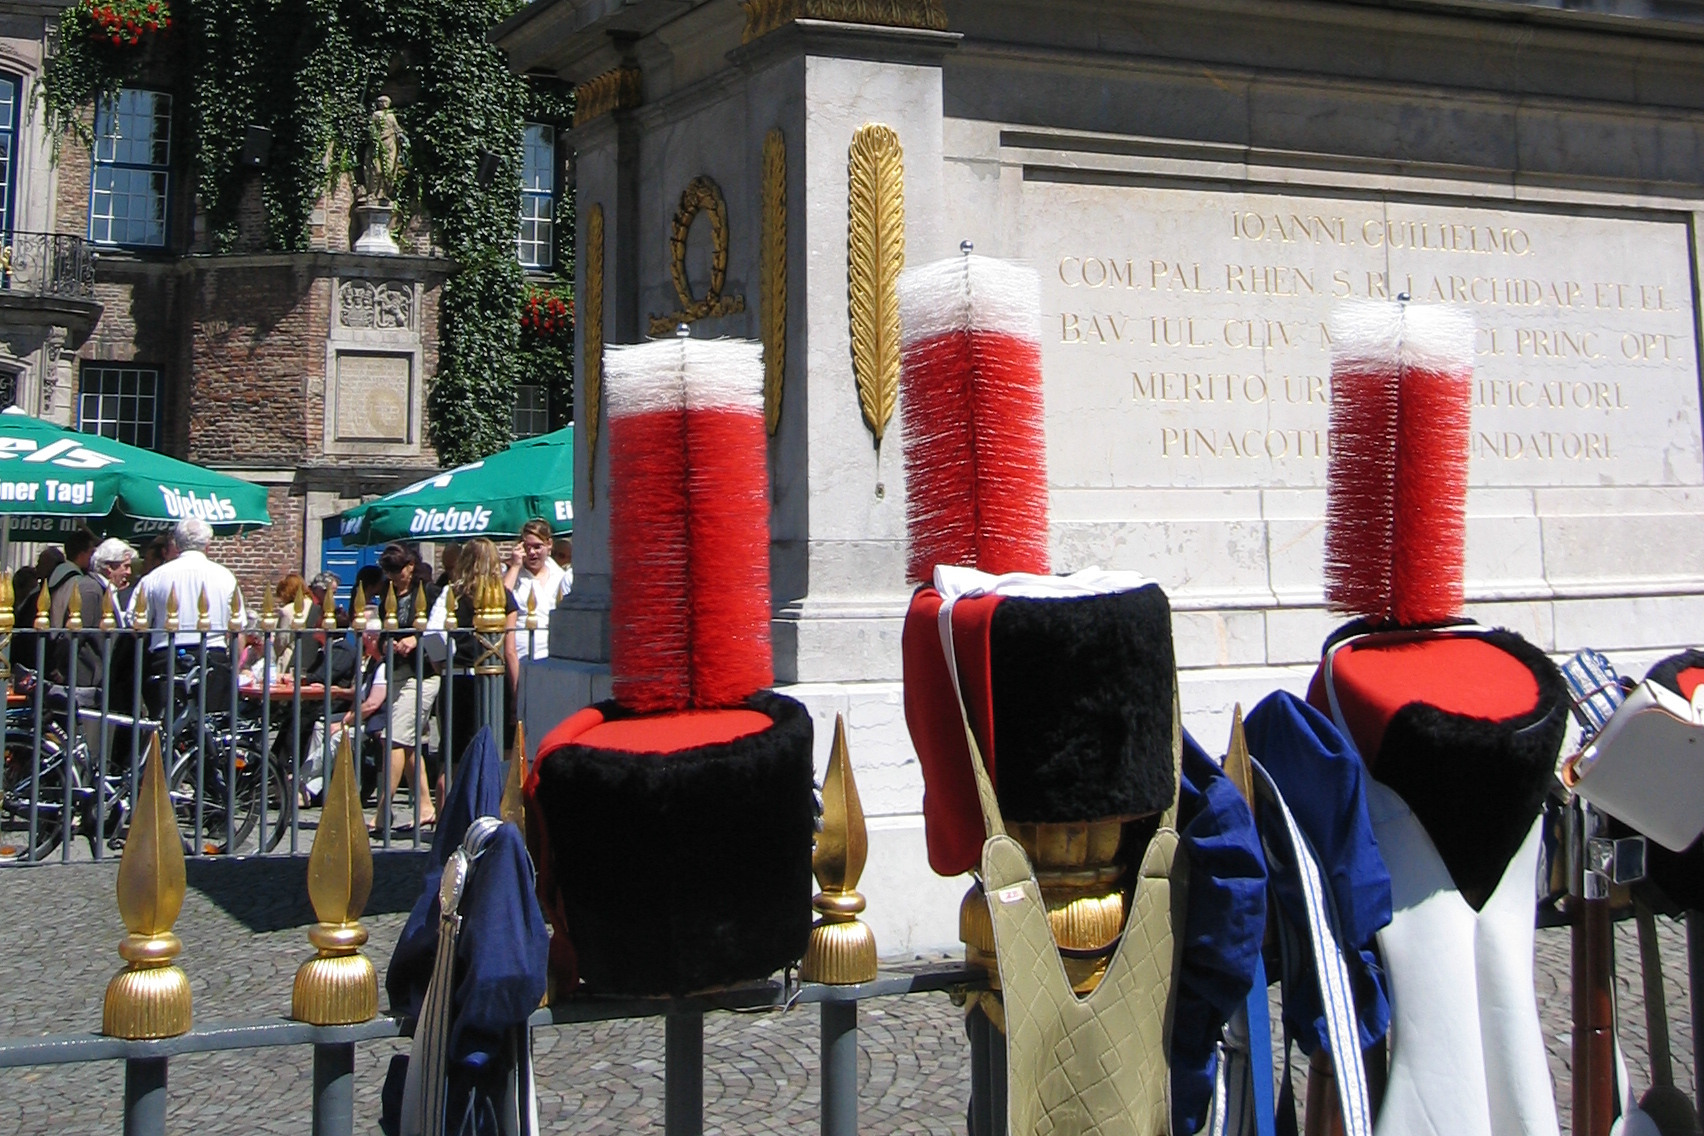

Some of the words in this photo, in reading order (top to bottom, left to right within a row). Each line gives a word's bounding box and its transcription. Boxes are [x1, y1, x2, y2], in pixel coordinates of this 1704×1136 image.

[1231, 211, 1355, 246] IOANNI.
[1362, 219, 1535, 256] GUILIELMO.
[1058, 256, 1142, 290] COM.
[1150, 260, 1220, 293] PAL.
[1225, 264, 1322, 297] RHEN.
[1331, 269, 1358, 298] S.
[1366, 271, 1395, 300] R.
[1427, 276, 1585, 308] ARCHIDAP.
[1594, 283, 1634, 310] ET.
[1640, 285, 1680, 312] EL.
[1060, 312, 1134, 345] BAV.
[1150, 316, 1213, 348] IUL.
[1224, 319, 1298, 350] CLIV.
[1515, 328, 1607, 359] PRINC.
[1621, 333, 1683, 361] OPT.
[1131, 371, 1275, 404] MERITO.
[1284, 375, 1328, 406] UR
[1161, 428, 1332, 459] PINACOTH
[0, 480, 39, 502] ner
[45, 480, 94, 505] Tag!
[554, 500, 573, 521] Ei
